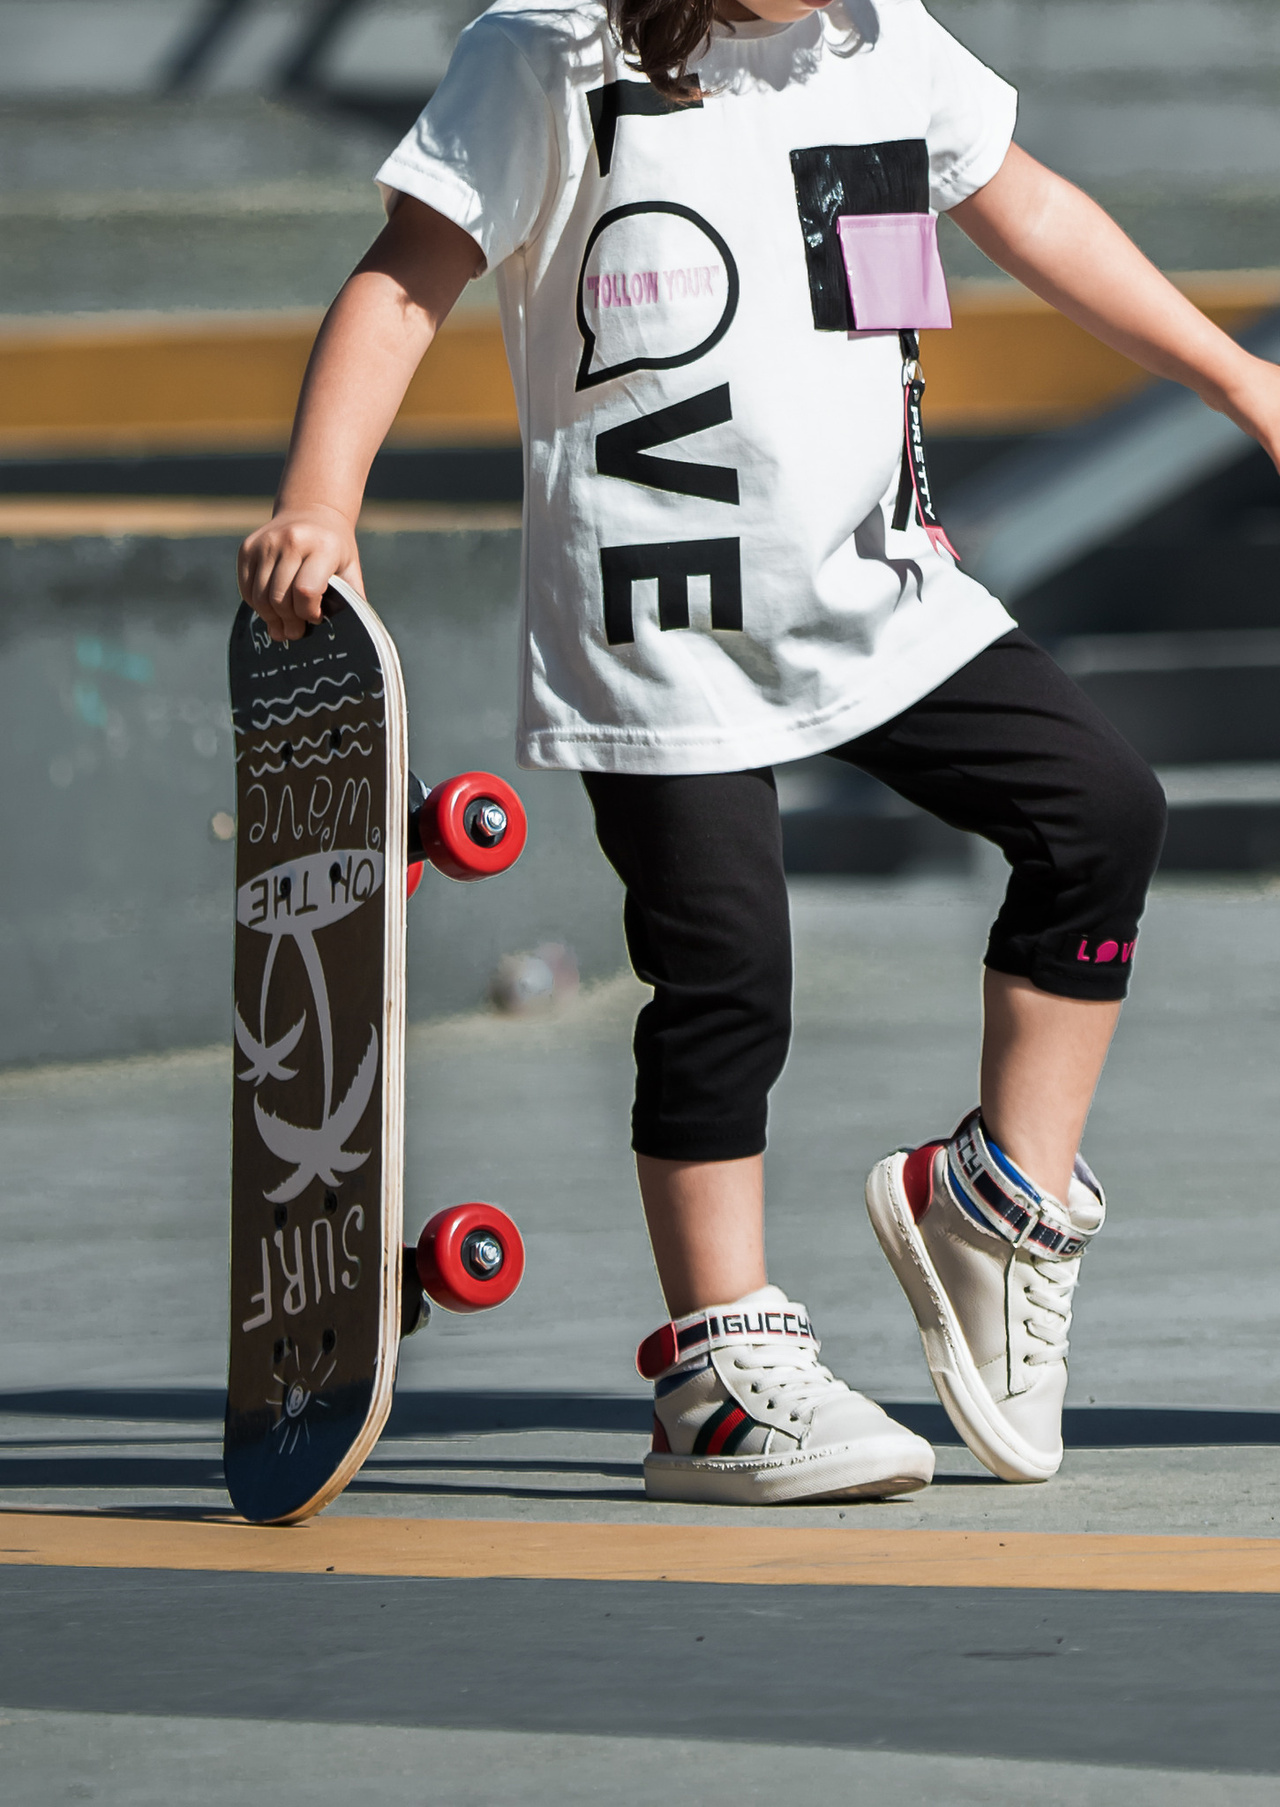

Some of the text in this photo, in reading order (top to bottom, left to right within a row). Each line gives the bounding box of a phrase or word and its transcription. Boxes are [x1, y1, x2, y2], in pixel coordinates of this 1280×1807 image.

[575, 73, 744, 647] LOVE
[910, 404, 936, 521] PRETTY
[248, 870, 318, 927] THE
[1077, 938, 1138, 963] LOV
[241, 1204, 366, 1332] SURF
